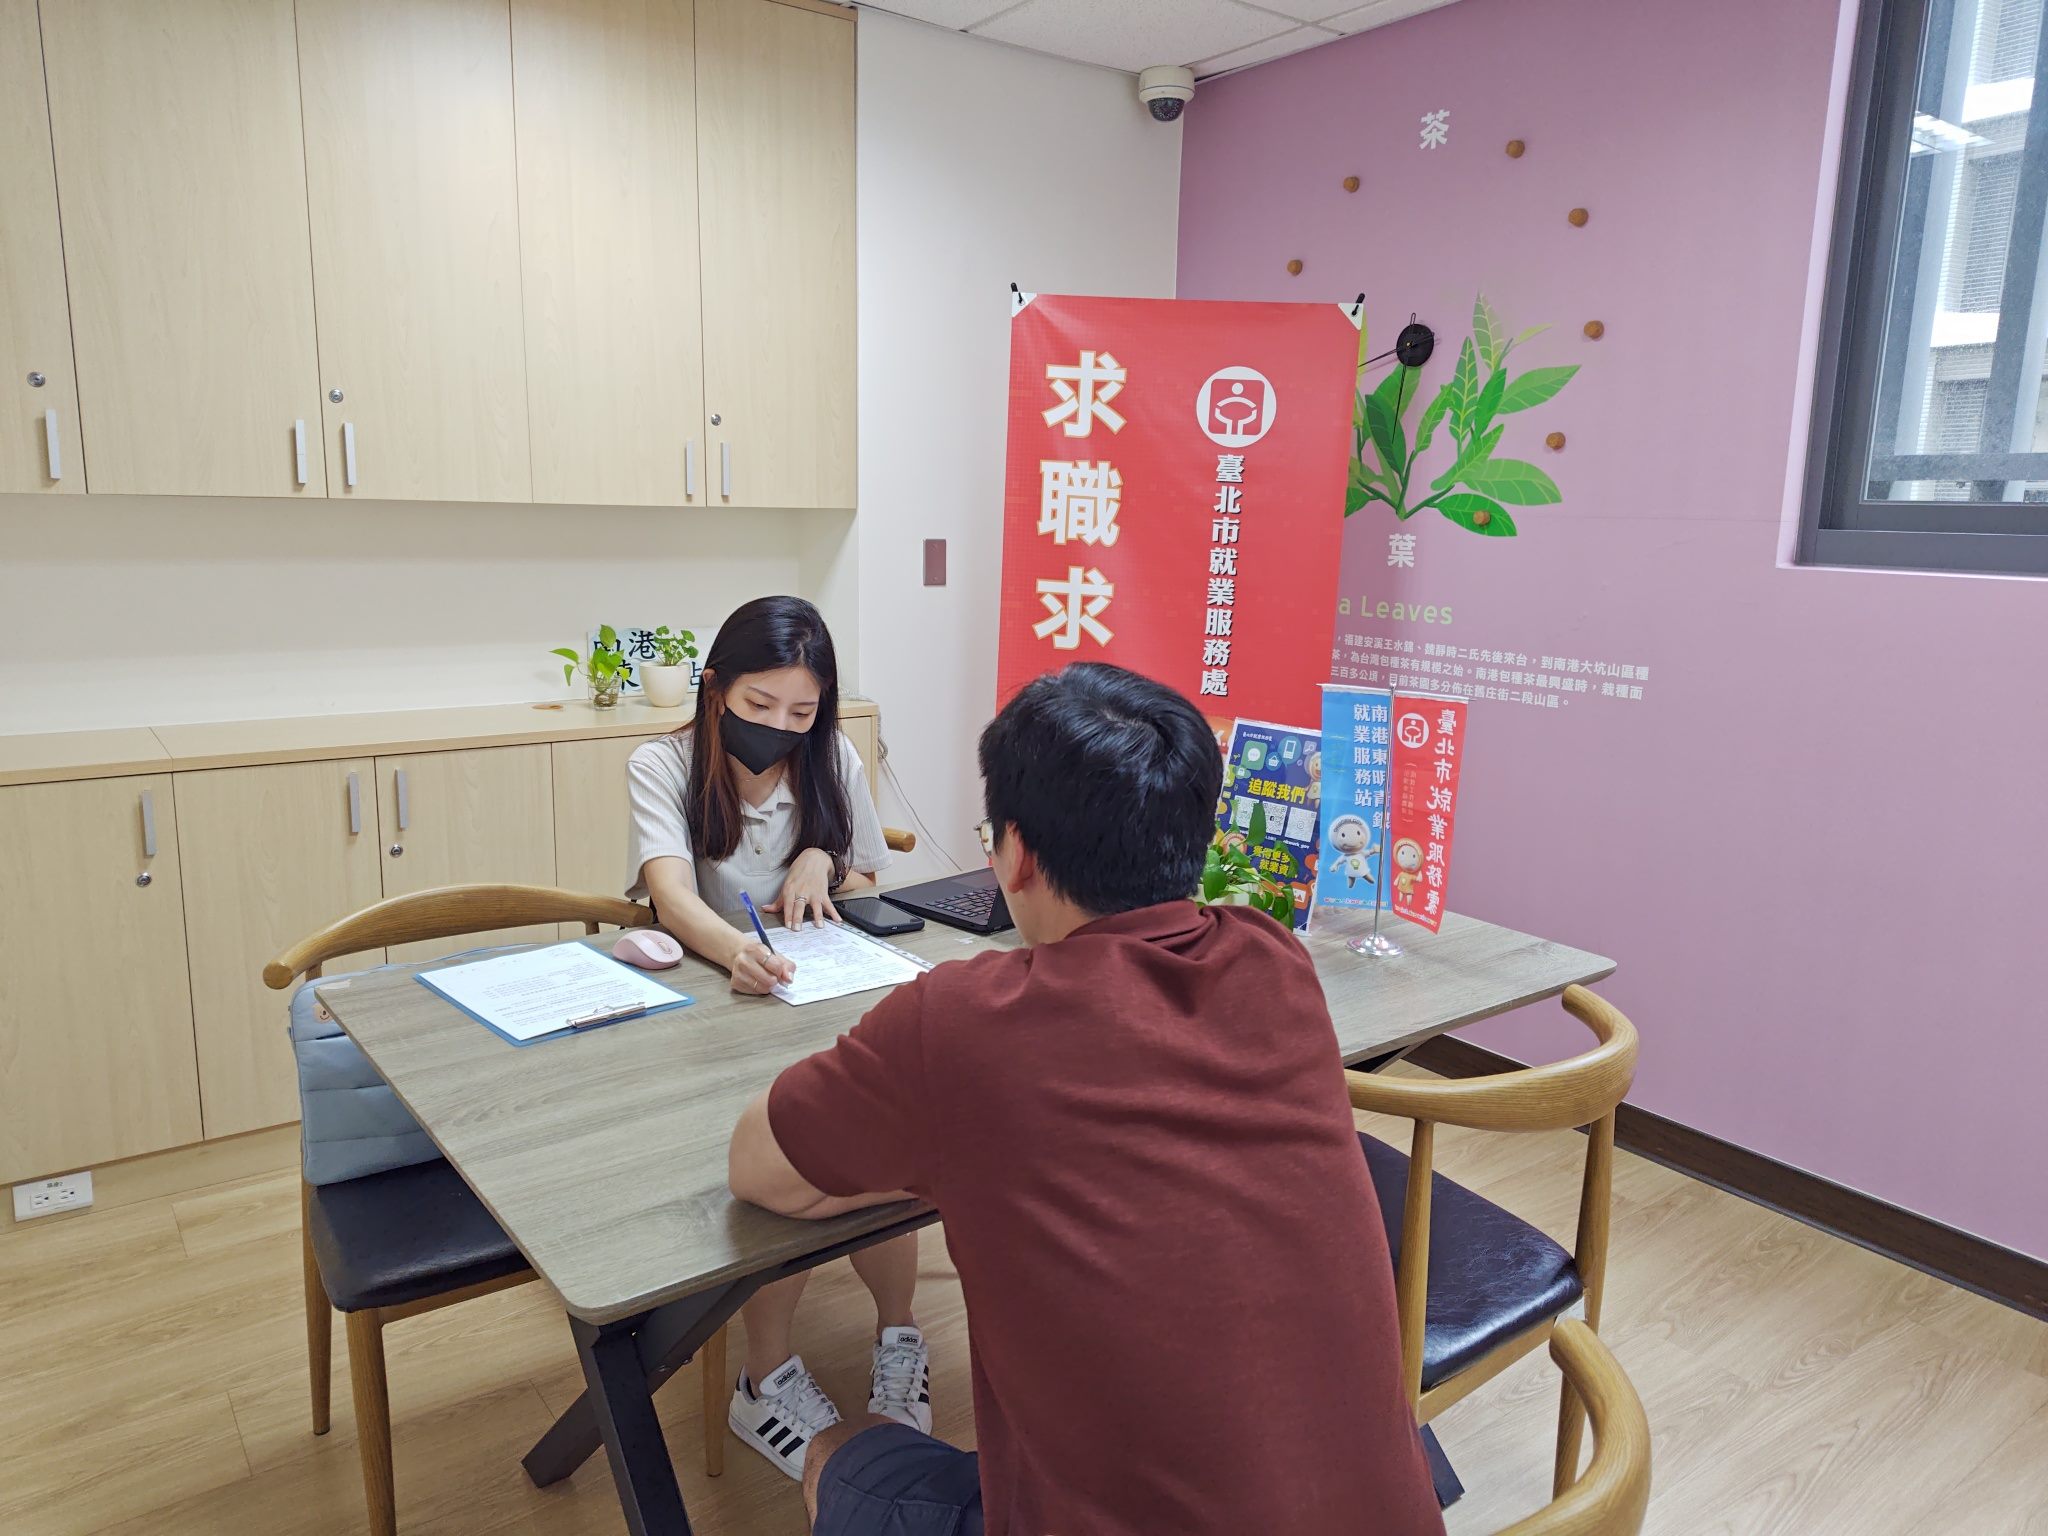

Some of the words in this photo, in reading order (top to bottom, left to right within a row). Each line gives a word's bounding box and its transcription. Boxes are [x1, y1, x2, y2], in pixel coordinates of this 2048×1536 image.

[1419, 109, 1450, 150] 茶
[1032, 350, 1128, 650] 求職求
[1387, 533, 1417, 568] 葉
[1200, 454, 1245, 697] 臺北市就業服務處
[1361, 596, 1453, 625] Leaves
[1353, 704, 1372, 807] 就業服務站
[1247, 778, 1306, 804] 追蹤我們
[1259, 859, 1290, 876] 就業資
[899, 1334, 918, 1344] adidas
[777, 1368, 797, 1386] adidas
